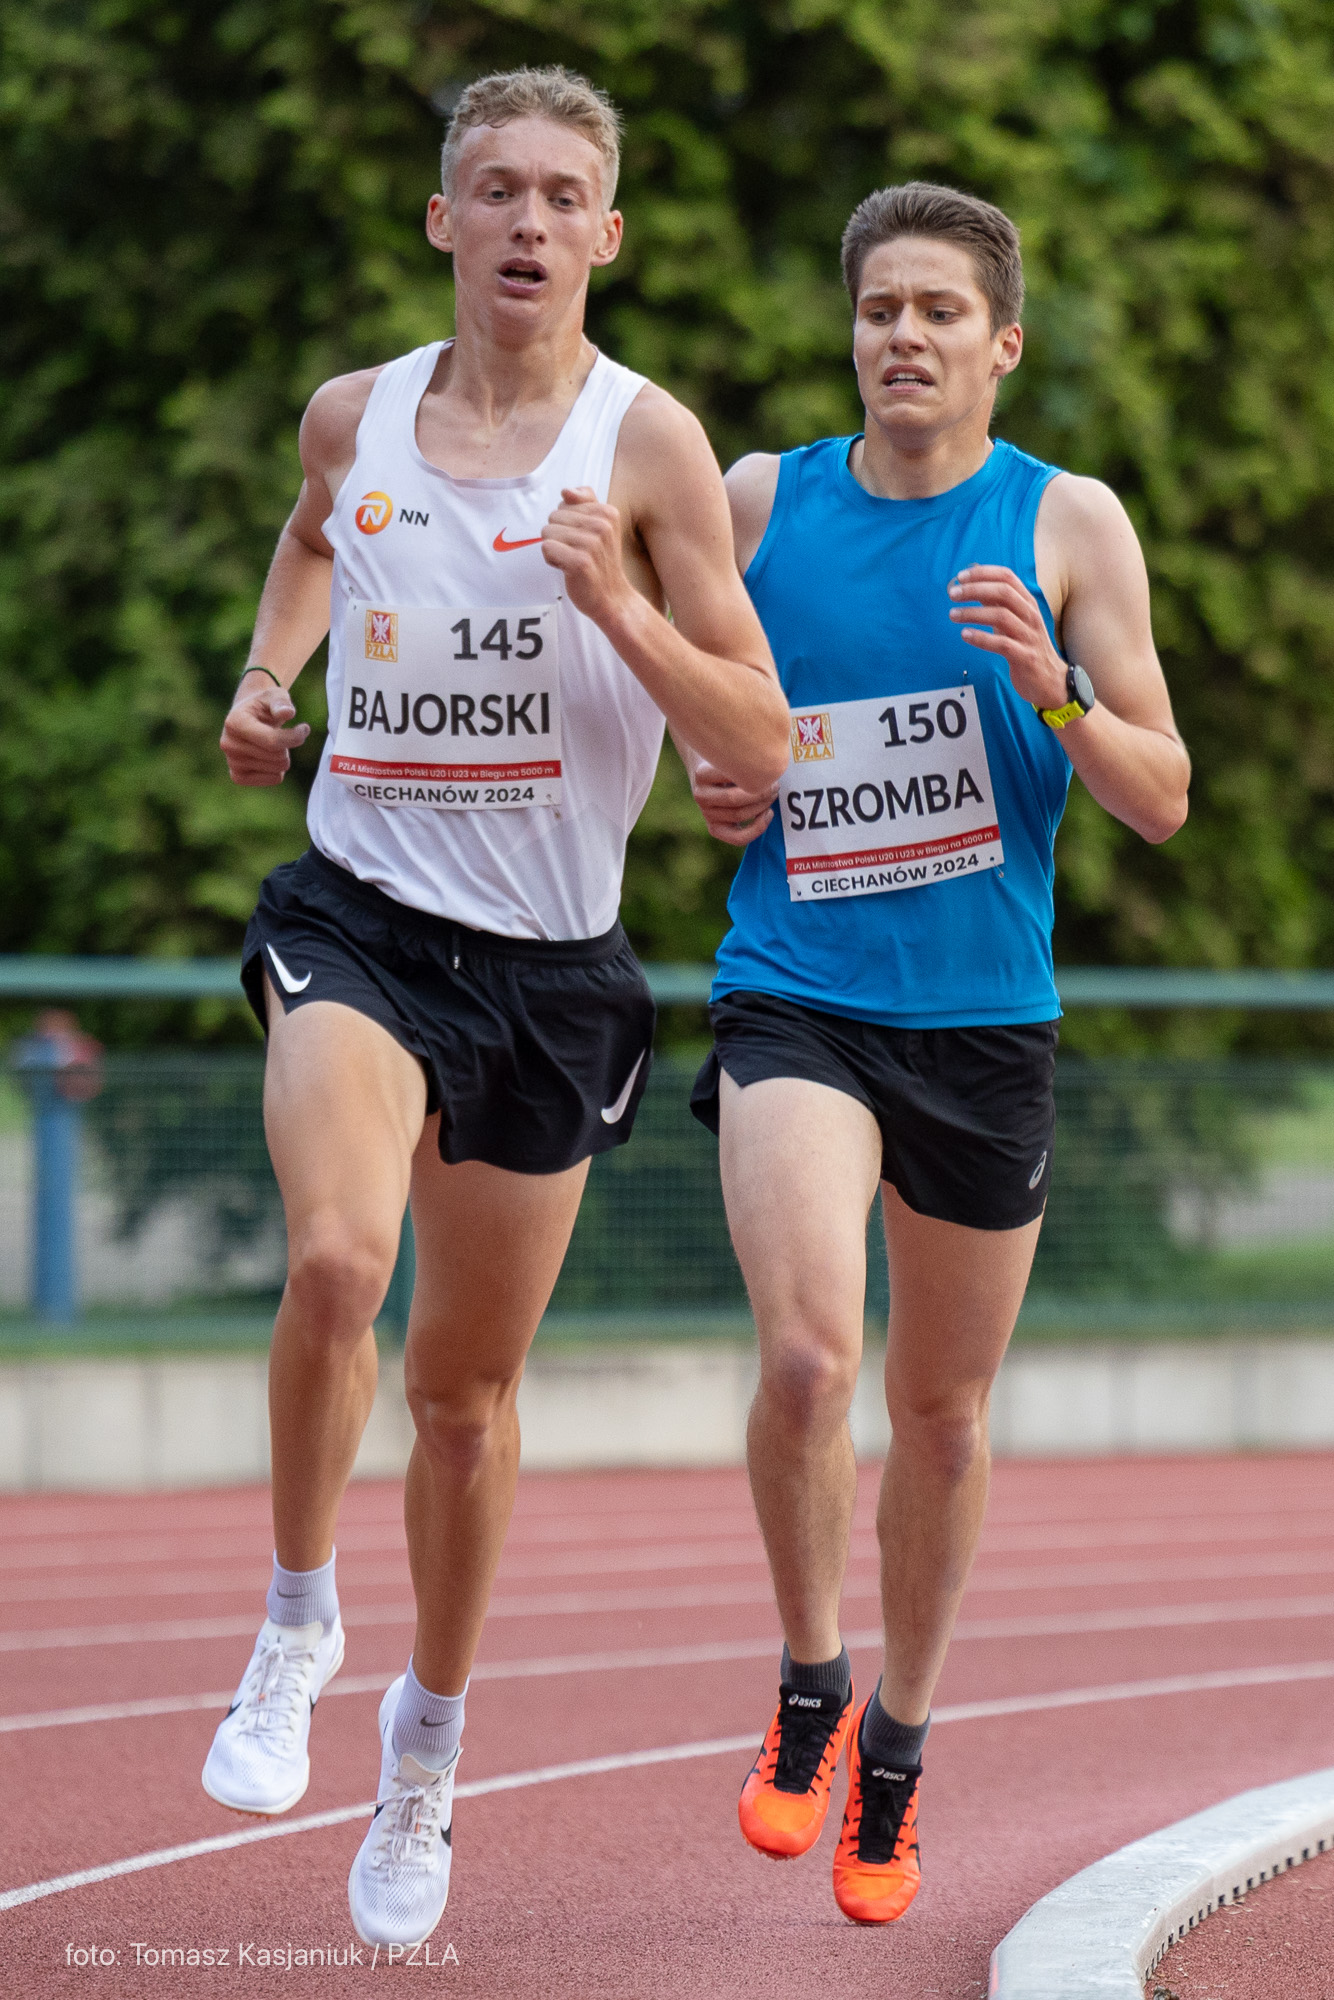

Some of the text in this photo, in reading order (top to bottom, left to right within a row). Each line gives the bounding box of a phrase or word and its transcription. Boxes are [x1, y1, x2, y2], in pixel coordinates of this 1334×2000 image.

[399, 508, 430, 527] NN
[450, 617, 544, 661] 145
[348, 686, 550, 737] BAJORSKI
[878, 698, 967, 748] 150
[358, 764, 403, 776] Mistrzostwa
[404, 768, 429, 777] Polski
[429, 769, 446, 778] U20
[453, 769, 469, 778] U23
[471, 770, 479, 778] w
[480, 769, 505, 780] Biegu
[506, 769, 519, 777] na
[521, 766, 543, 776] 5000
[354, 784, 535, 804] CIECHANÓW 2024
[787, 768, 984, 831] SZROMBA
[855, 854, 878, 865] Polski
[878, 852, 894, 862] U20
[900, 849, 915, 859] U23
[925, 843, 949, 856] Biegu
[950, 840, 961, 849] na
[962, 833, 983, 845] 5000
[811, 853, 979, 894] CIECHANÓW 2024
